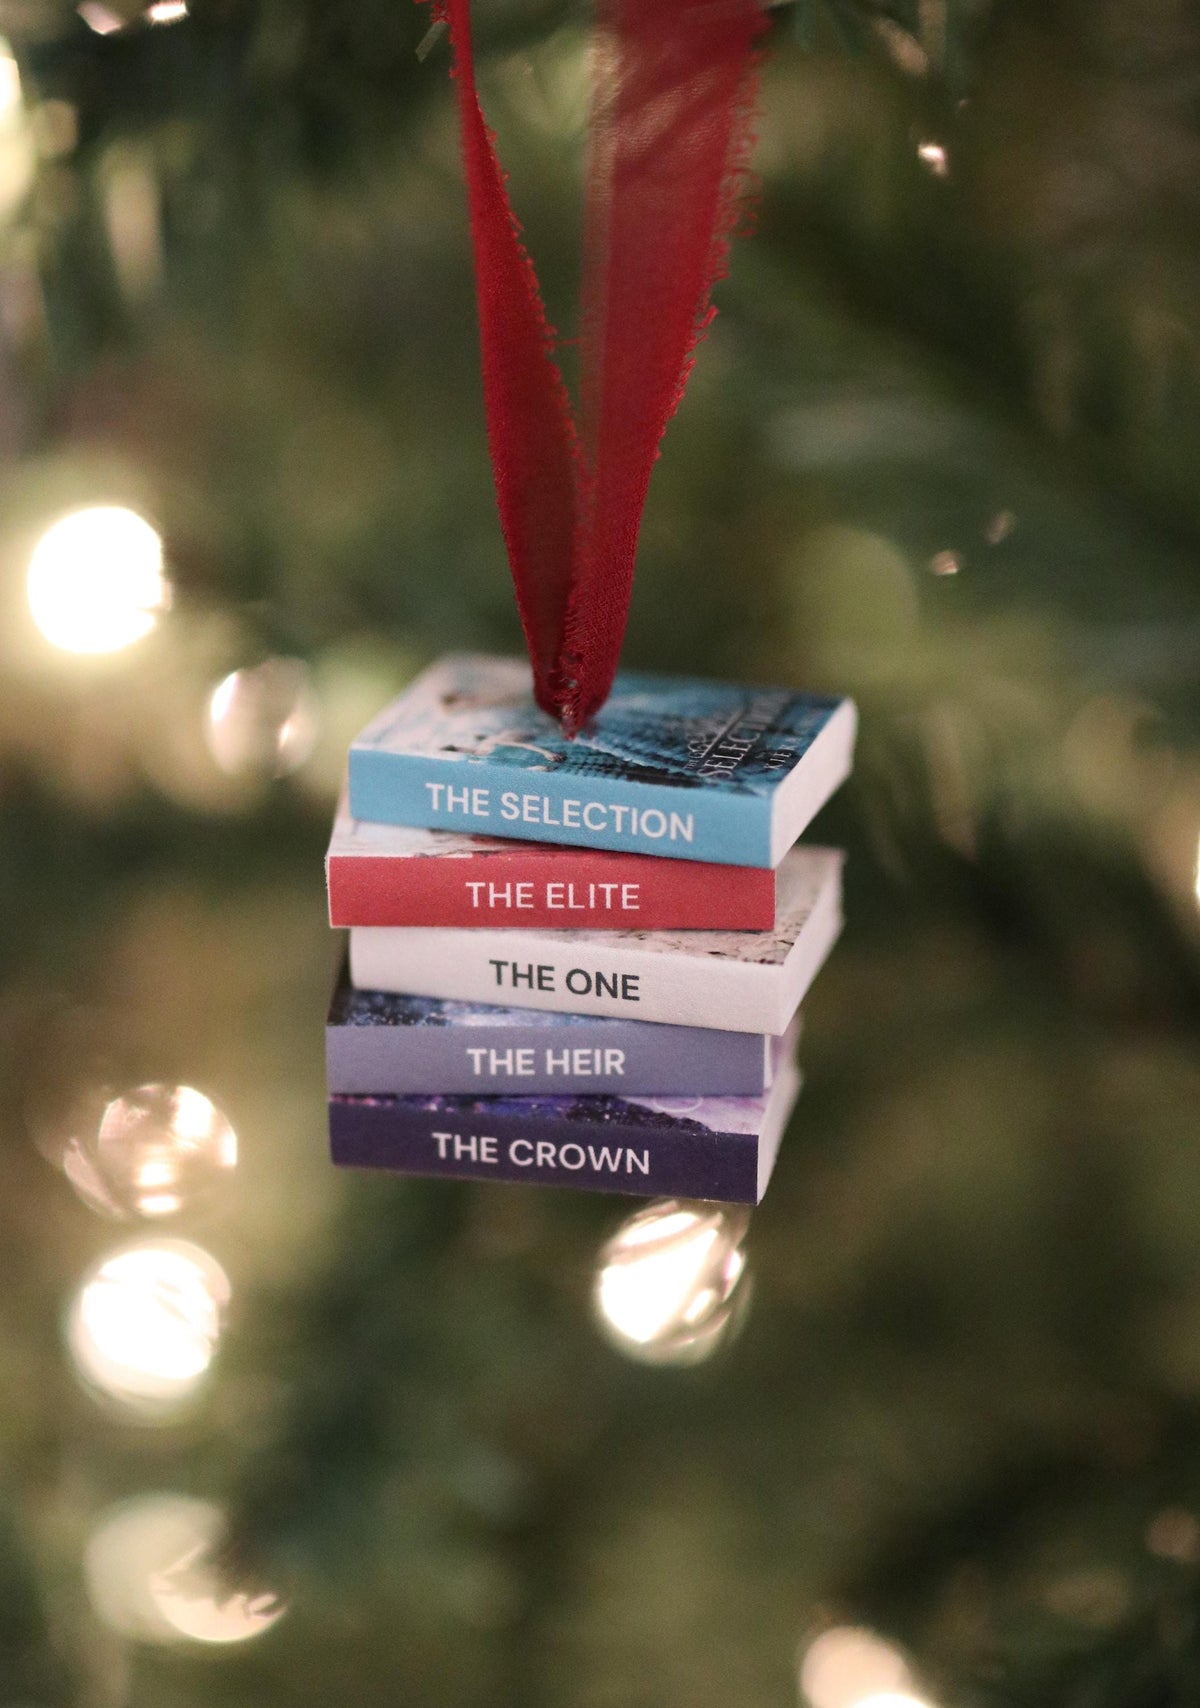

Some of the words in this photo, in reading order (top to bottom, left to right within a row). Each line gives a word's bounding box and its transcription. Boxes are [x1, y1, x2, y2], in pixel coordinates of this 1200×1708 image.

[696, 691, 791, 779] SELECT
[425, 782, 489, 818] THE
[500, 791, 695, 843] SELECTION
[465, 882, 534, 909] THE
[546, 883, 641, 910] ELITE
[489, 959, 555, 992] THE
[565, 968, 640, 1002] ONE
[467, 1047, 536, 1076] THE
[546, 1048, 626, 1076] HEIR
[431, 1132, 499, 1164] THE
[508, 1139, 651, 1175] CROWN
